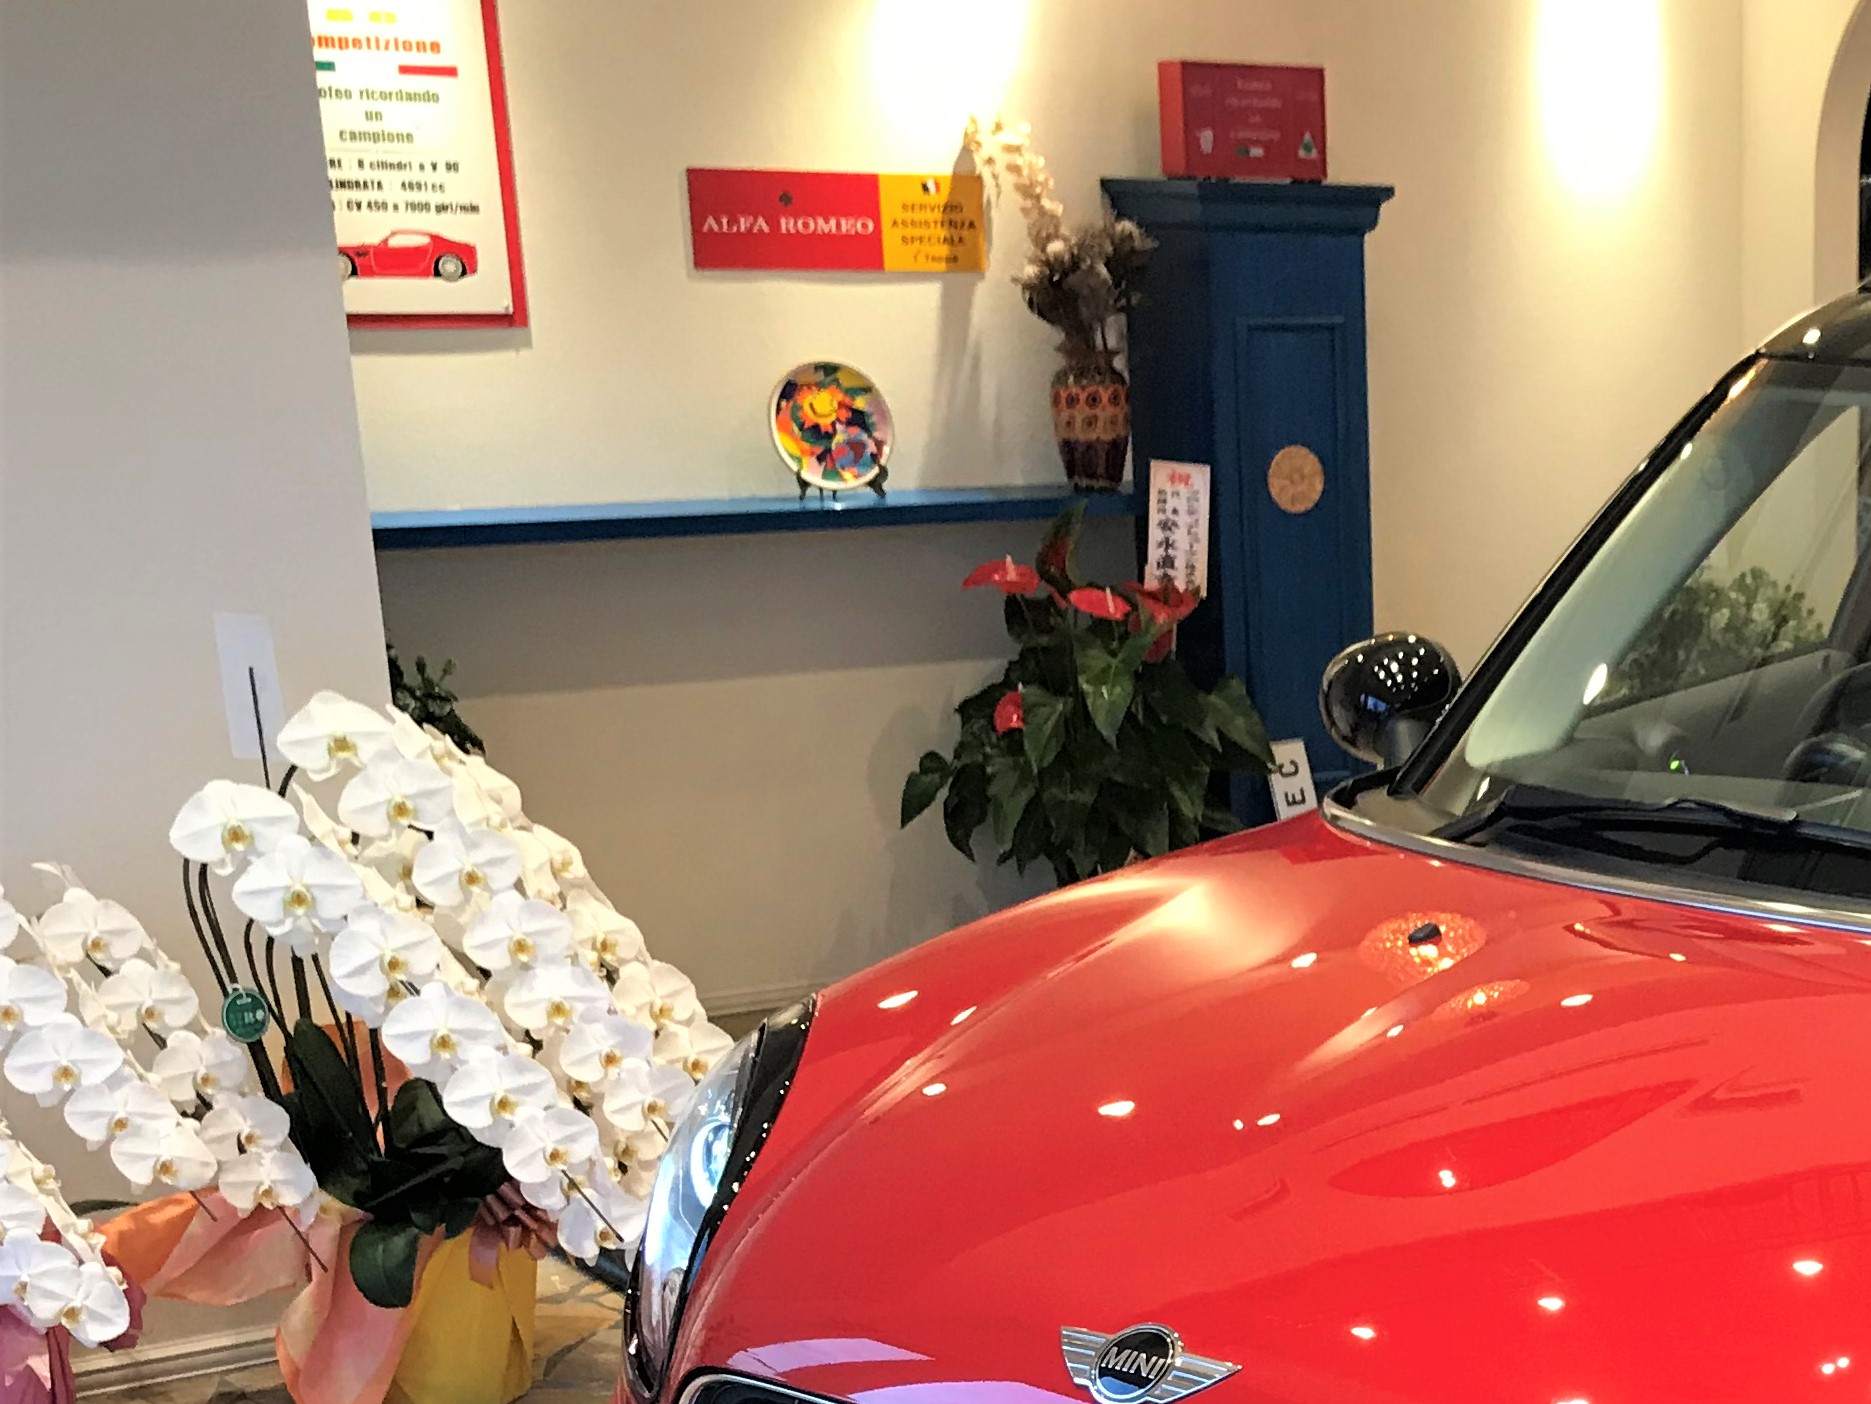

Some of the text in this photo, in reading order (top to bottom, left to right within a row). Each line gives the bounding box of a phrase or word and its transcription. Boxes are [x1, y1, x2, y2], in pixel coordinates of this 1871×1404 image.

[359, 86, 440, 104] ricordando
[365, 110, 383, 122] un
[339, 129, 414, 144] campione
[702, 214, 875, 236] ALFA ROMEO
[1101, 1346, 1165, 1379] MINI
